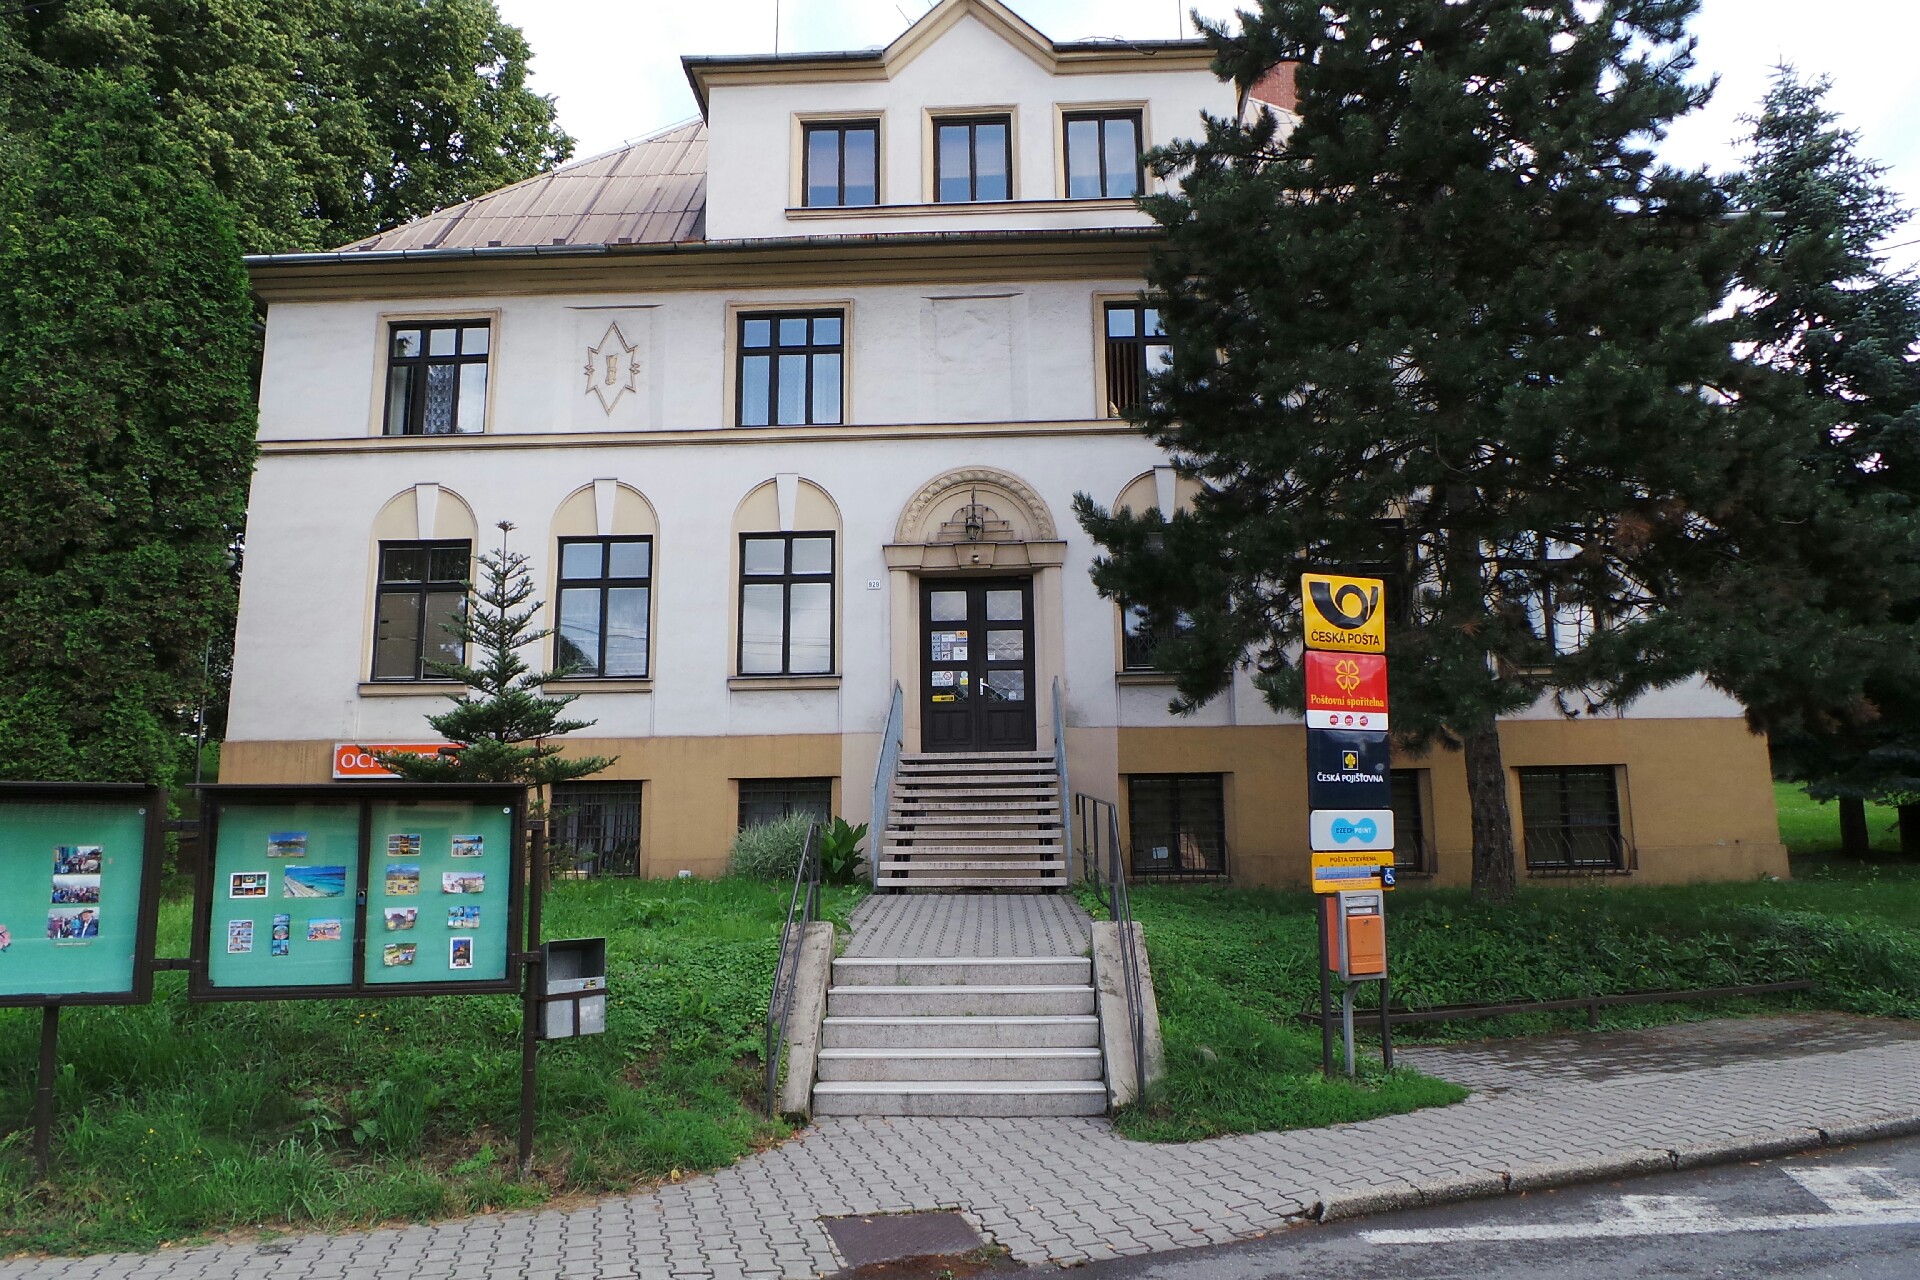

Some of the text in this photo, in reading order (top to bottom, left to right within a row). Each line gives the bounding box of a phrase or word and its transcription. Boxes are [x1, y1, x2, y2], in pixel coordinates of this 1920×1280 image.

[1311, 629, 1380, 645] ČESKÁ POŠTA
[1311, 694, 1384, 708] Poštovní spořitelna
[1317, 772, 1384, 783] ČESKÁ POJIŠŤOVNA
[1330, 855, 1349, 863] POŠTA
